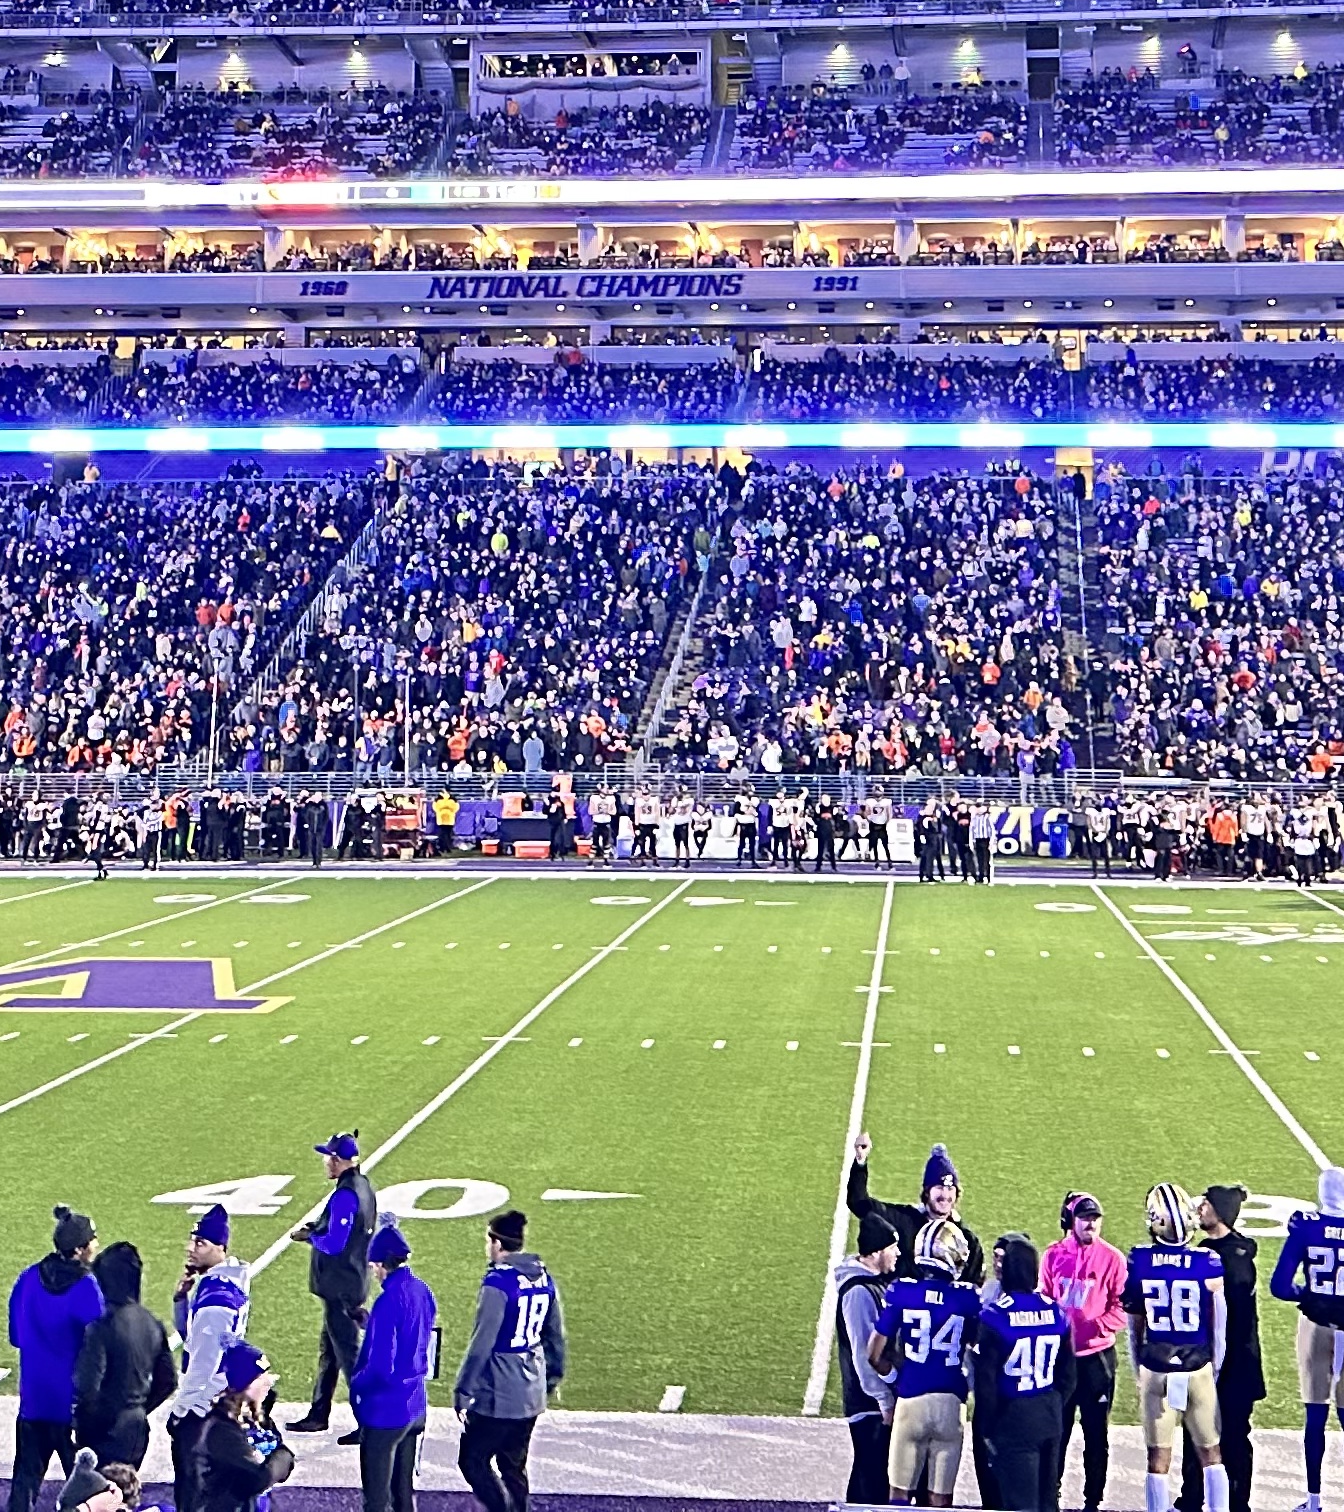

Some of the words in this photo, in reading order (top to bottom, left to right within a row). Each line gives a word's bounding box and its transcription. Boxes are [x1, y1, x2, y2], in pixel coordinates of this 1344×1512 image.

[427, 276, 569, 299] NATIONAL
[576, 274, 744, 297] CHAMPIONS
[813, 275, 858, 292] 1991
[511, 1294, 550, 1348] 18
[1141, 1279, 1201, 1332] 28
[902, 1308, 965, 1366] 34
[1004, 1334, 1060, 1391] 40
